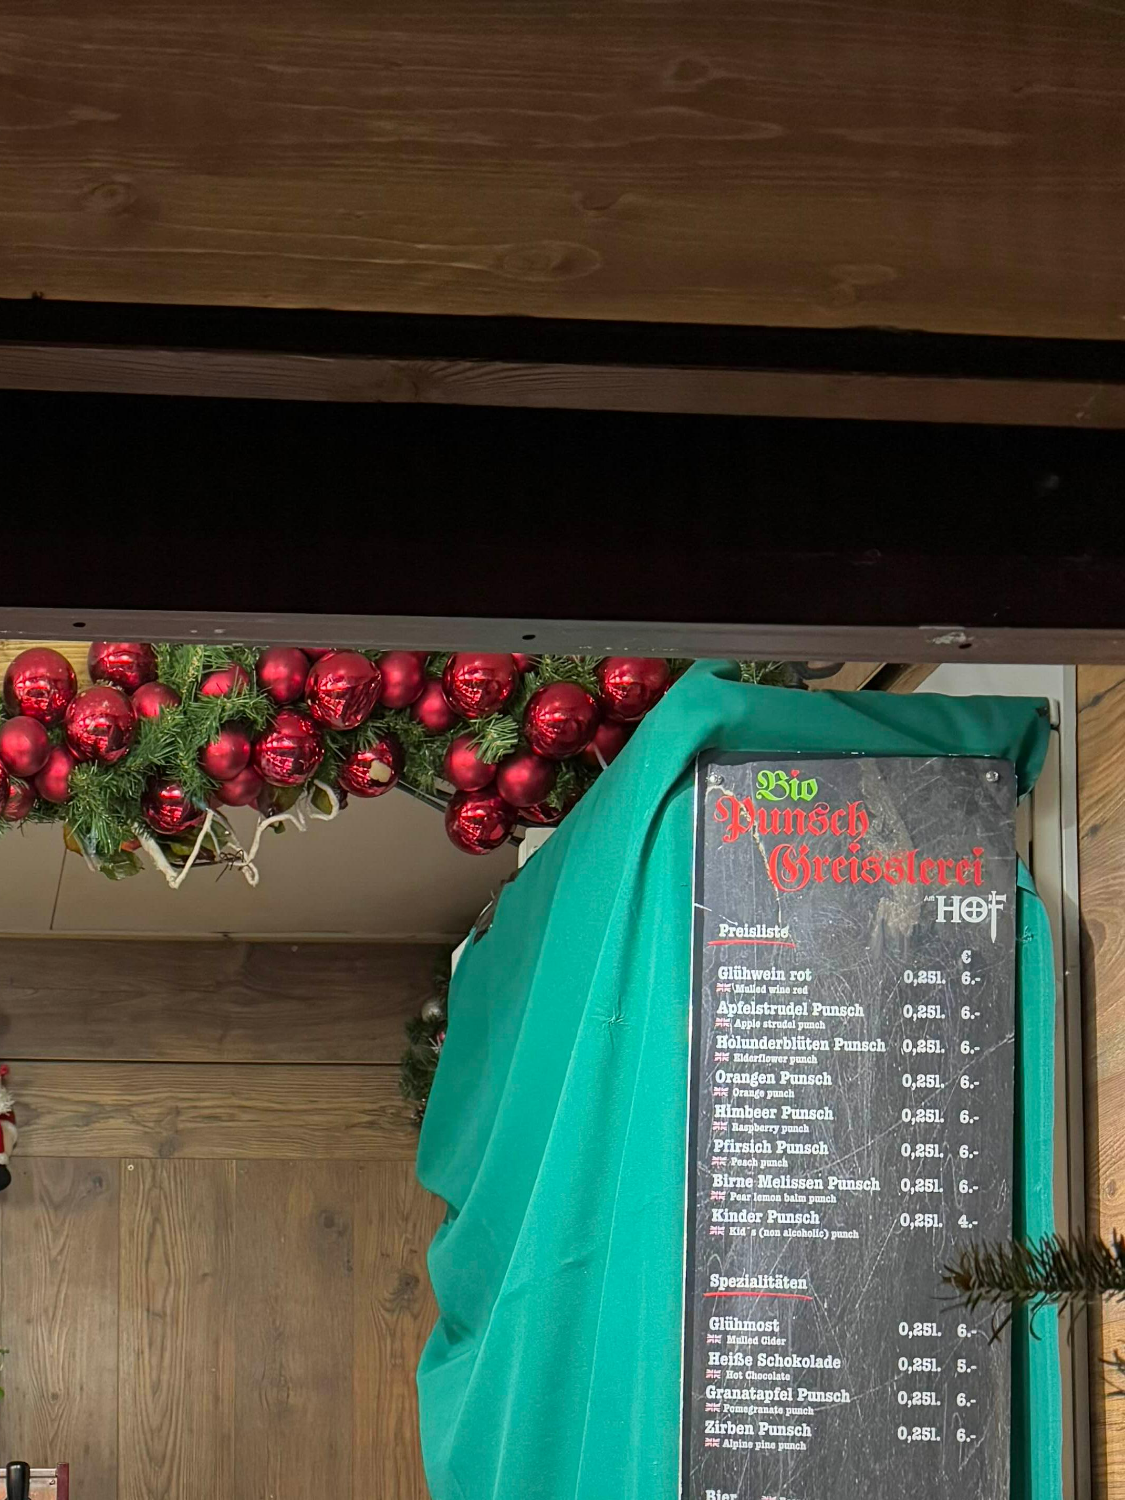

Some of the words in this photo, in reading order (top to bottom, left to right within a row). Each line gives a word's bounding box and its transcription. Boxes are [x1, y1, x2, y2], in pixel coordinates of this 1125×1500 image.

[756, 770, 817, 802] Bio
[714, 796, 868, 842] Punsch
[769, 843, 984, 892] Greisslerei
[719, 924, 789, 939] Preisliste
[962, 950, 972, 963] €
[718, 966, 783, 982] Glühwein
[787, 967, 811, 981] rot
[962, 972, 981, 985] 6.-
[717, 1002, 809, 1019] Apfelstrudel
[812, 1002, 864, 1018] Punsch
[961, 1006, 980, 1019] 6.-
[798, 1019, 826, 1030] punch
[716, 1036, 830, 1052] Holunderblüten
[834, 1037, 886, 1052] Punsch
[715, 1071, 775, 1088] Orangen
[779, 1071, 832, 1087] Punsch
[960, 1076, 980, 1089] 6.-
[732, 1088, 765, 1099] Orange
[768, 1088, 794, 1099] punch
[715, 1105, 777, 1121] Himbeer
[781, 1106, 834, 1121] Punsch
[782, 1124, 809, 1134] punch
[714, 1139, 772, 1155] Pfirsich
[776, 1140, 829, 1156] Punsch
[960, 1146, 979, 1159] 6.-
[713, 1174, 752, 1190] Birne
[757, 1173, 824, 1190] Melissen
[828, 1176, 880, 1191] Punsch
[712, 1209, 762, 1225] Kinder
[767, 1210, 820, 1225] Punsch
[958, 1215, 978, 1229] 4.-
[710, 1274, 808, 1291] Spezialitäten
[709, 1317, 779, 1332] Glühmost
[957, 1324, 977, 1337] 6.-
[727, 1335, 757, 1345] Mulled
[760, 1336, 786, 1346] Cider
[708, 1352, 753, 1367] Heiße
[757, 1354, 841, 1369] Schokolade
[957, 1360, 977, 1373] 5.-
[726, 1371, 742, 1379] Hot
[745, 1371, 790, 1380] Chocolate
[706, 1385, 793, 1402] Granatapfel
[797, 1388, 851, 1403] Punsch
[723, 1405, 783, 1416] Pomegranate
[786, 1406, 814, 1416] punch
[705, 1421, 754, 1436] Zirben
[758, 1422, 812, 1437] Punsch
